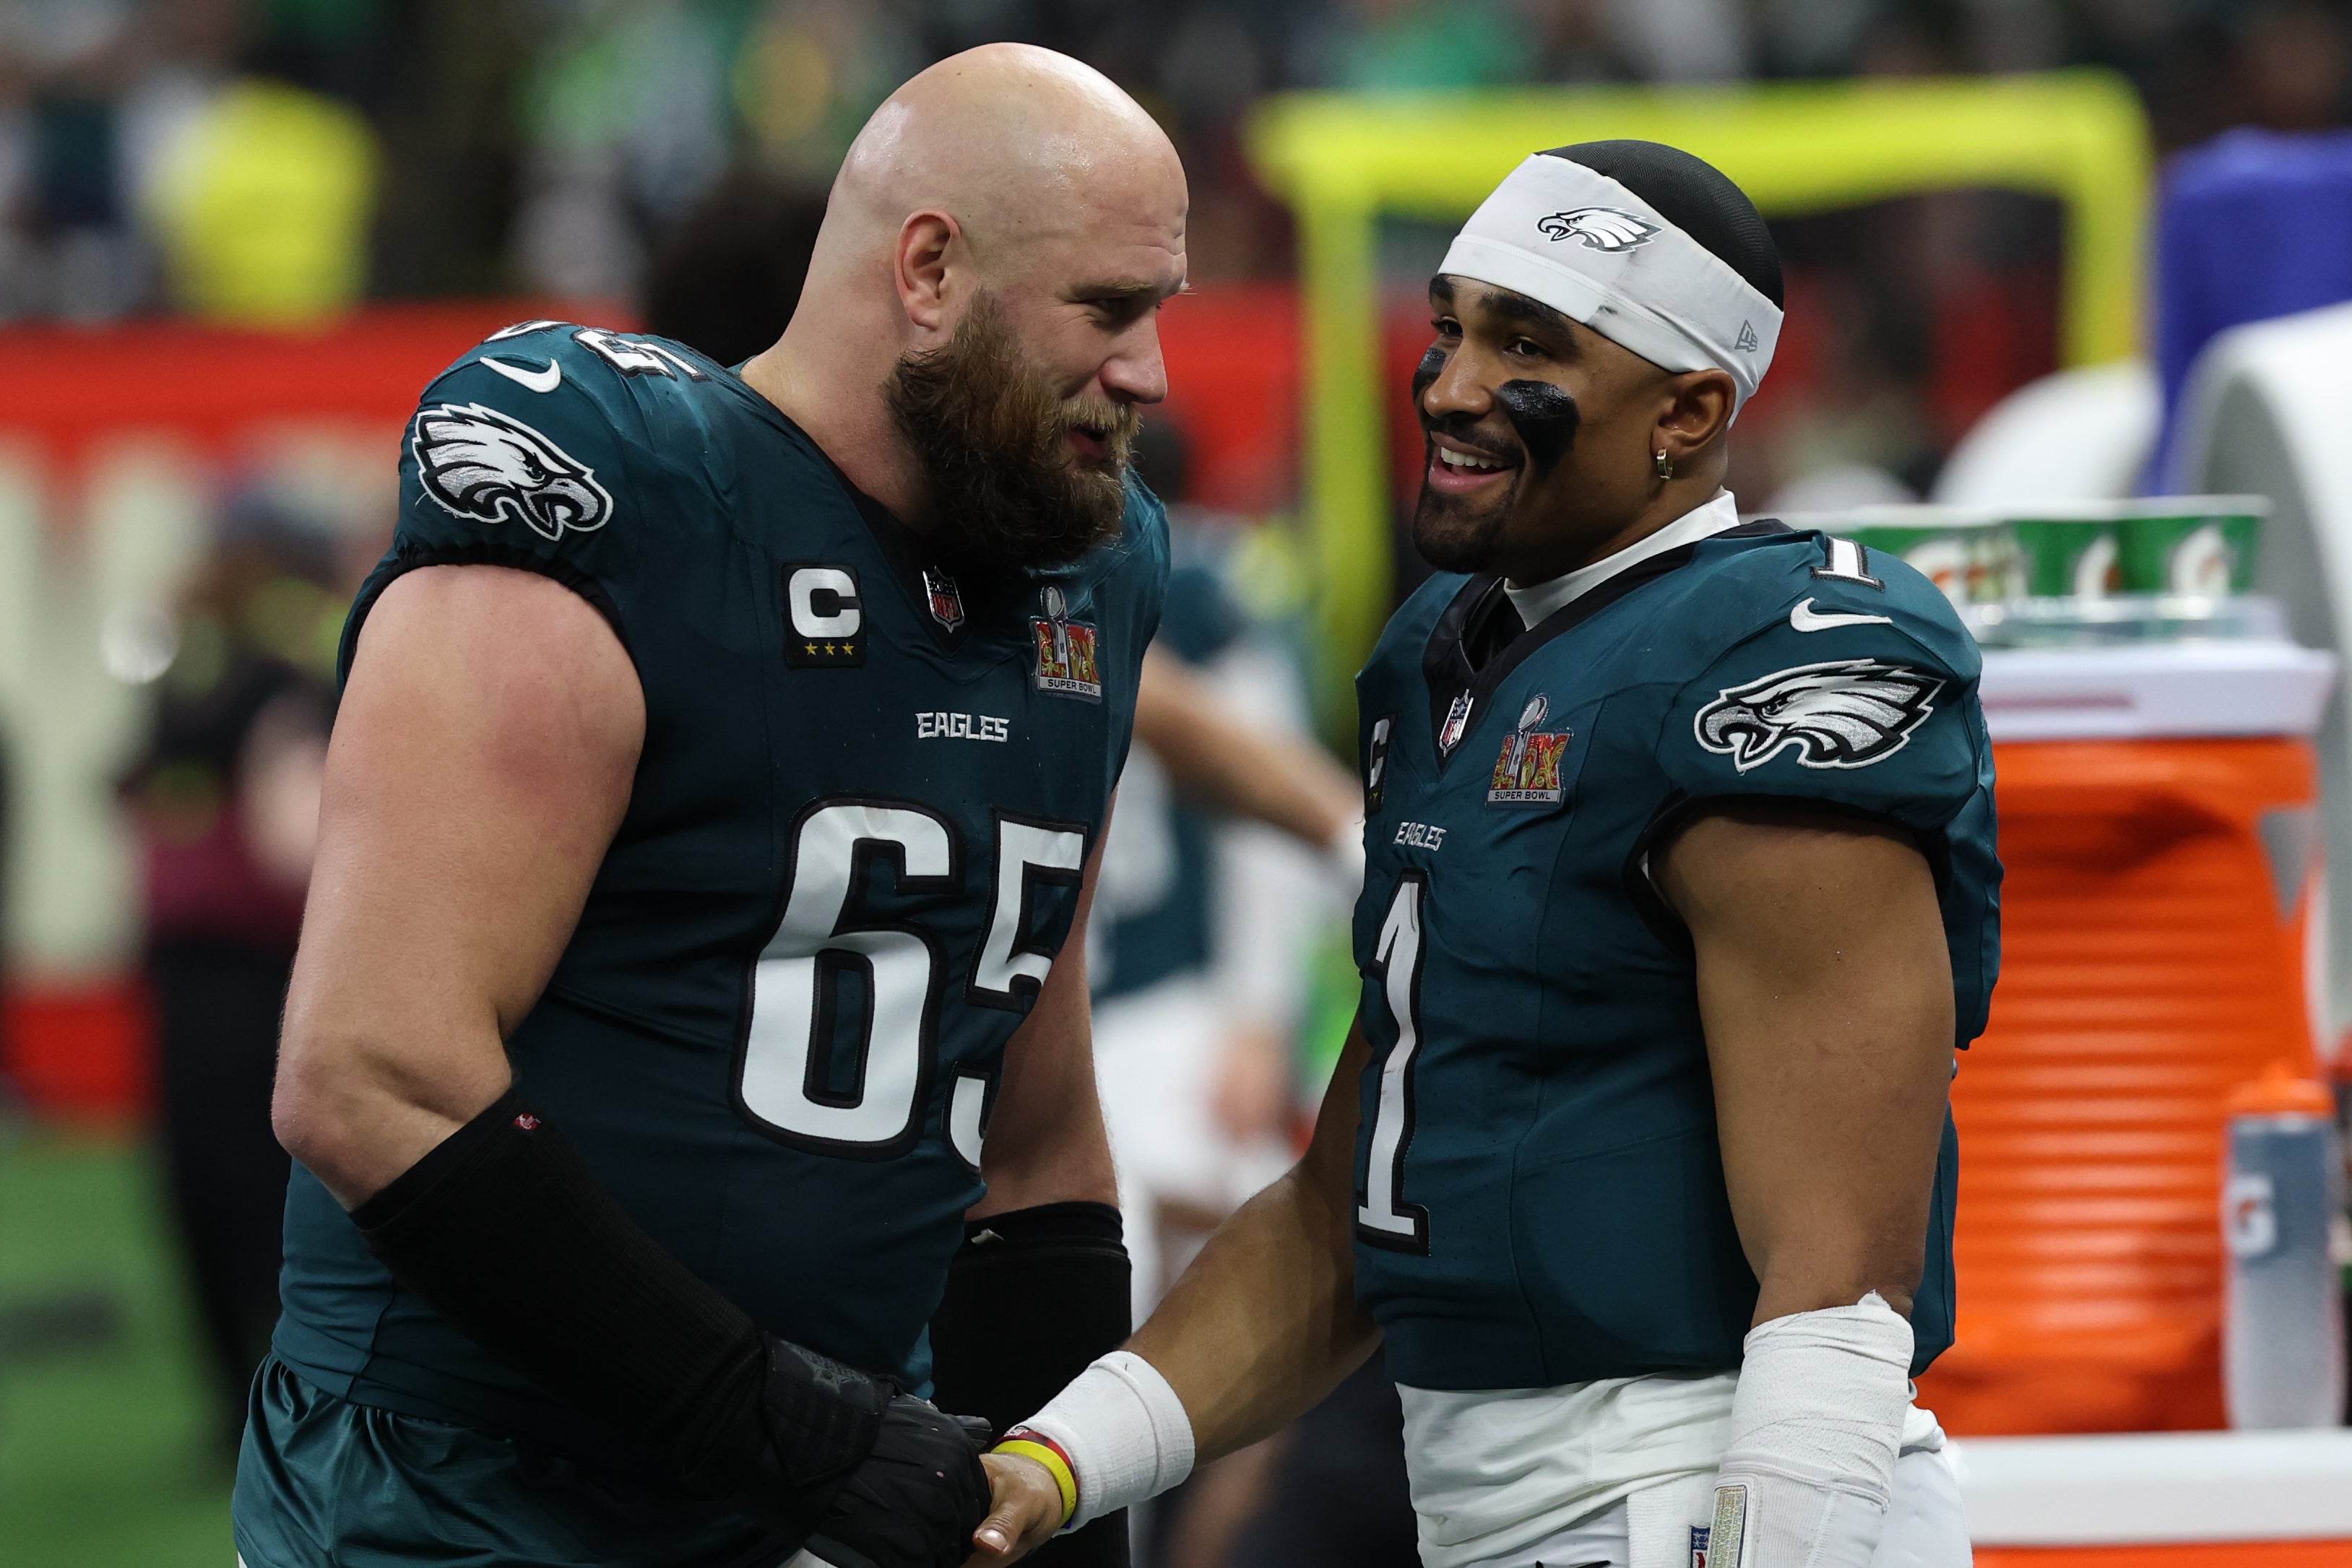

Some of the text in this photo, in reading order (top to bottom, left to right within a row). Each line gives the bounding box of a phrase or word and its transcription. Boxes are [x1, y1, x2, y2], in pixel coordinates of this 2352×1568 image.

[789, 568, 860, 638] C
[1047, 679, 1097, 694] SUPER BOWL
[915, 712, 1010, 742] EAGLES
[1393, 822, 1447, 852] EAGLES
[733, 799, 1088, 1174] 65
[1356, 872, 1427, 1248] 1
